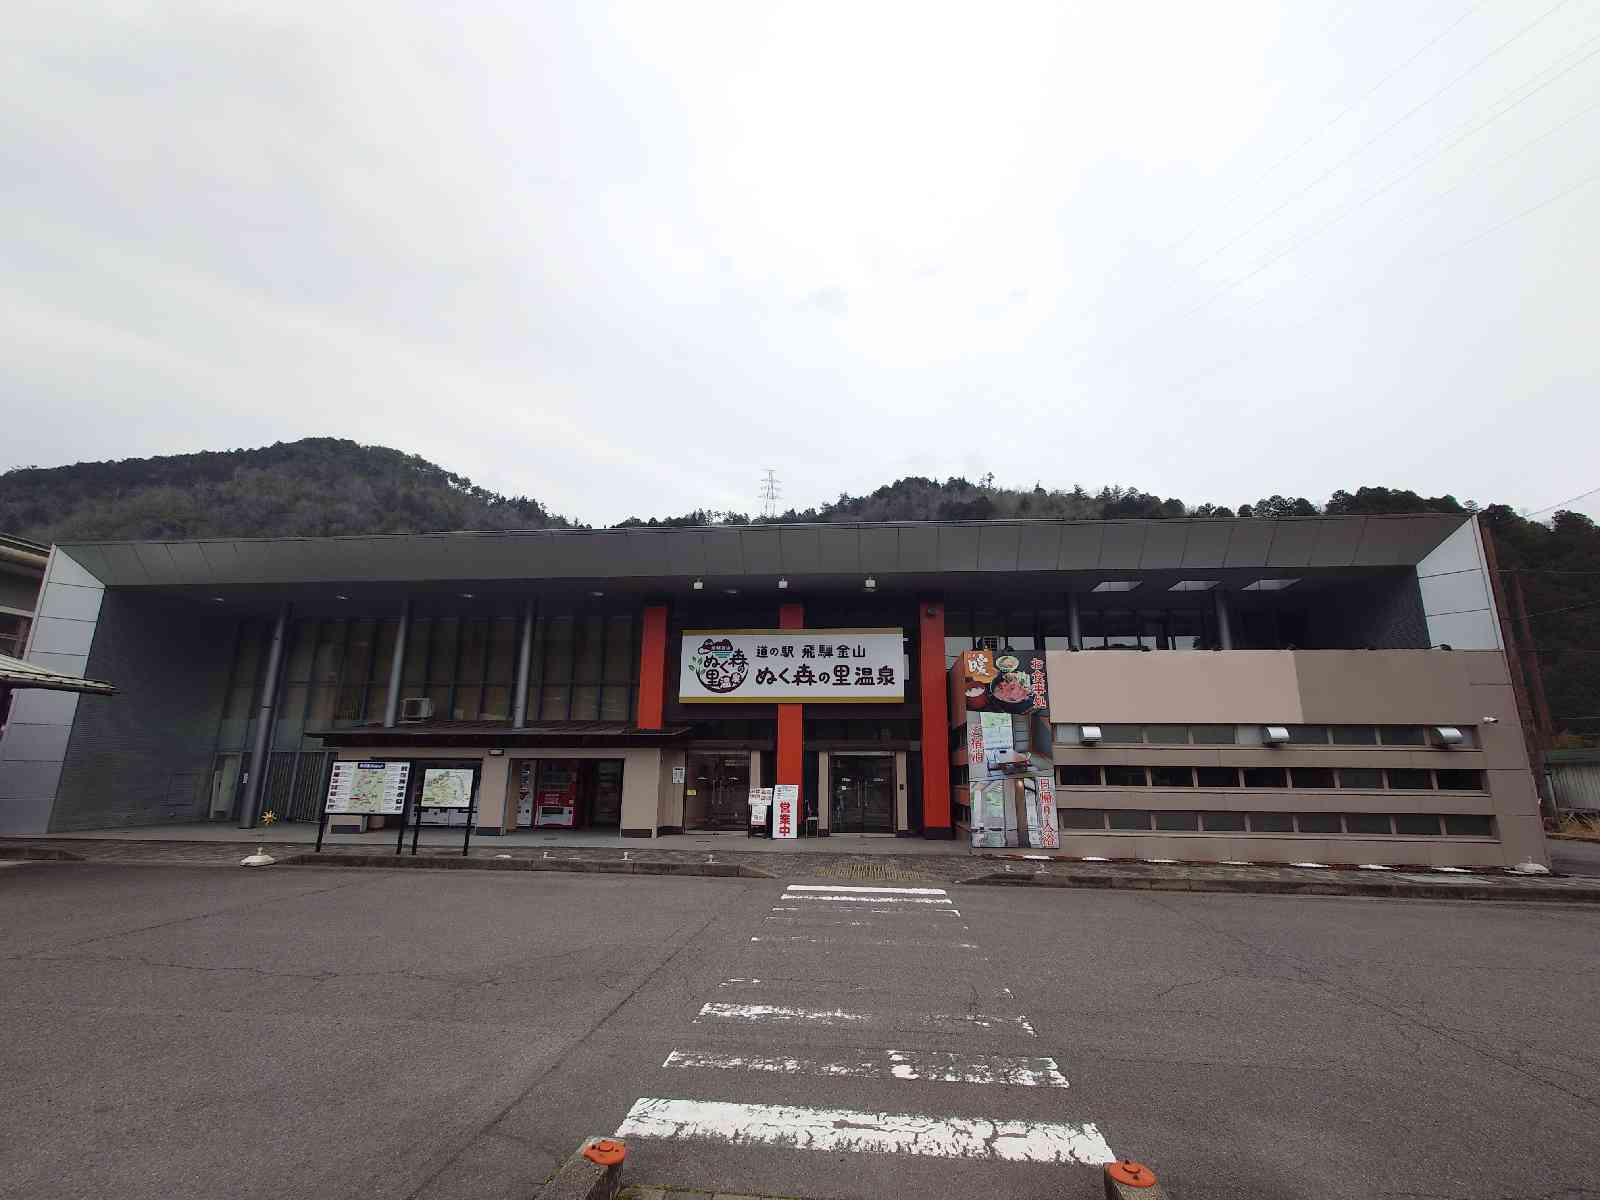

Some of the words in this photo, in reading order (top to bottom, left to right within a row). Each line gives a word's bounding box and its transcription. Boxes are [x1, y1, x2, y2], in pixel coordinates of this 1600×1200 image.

[756, 644, 794, 658] 道の駅
[801, 644, 866, 658] 飛騨金山
[755, 664, 895, 686] ぬく森の里温泉
[779, 801, 791, 837] 営業中
[1039, 777, 1055, 847] 日帰り入浴
